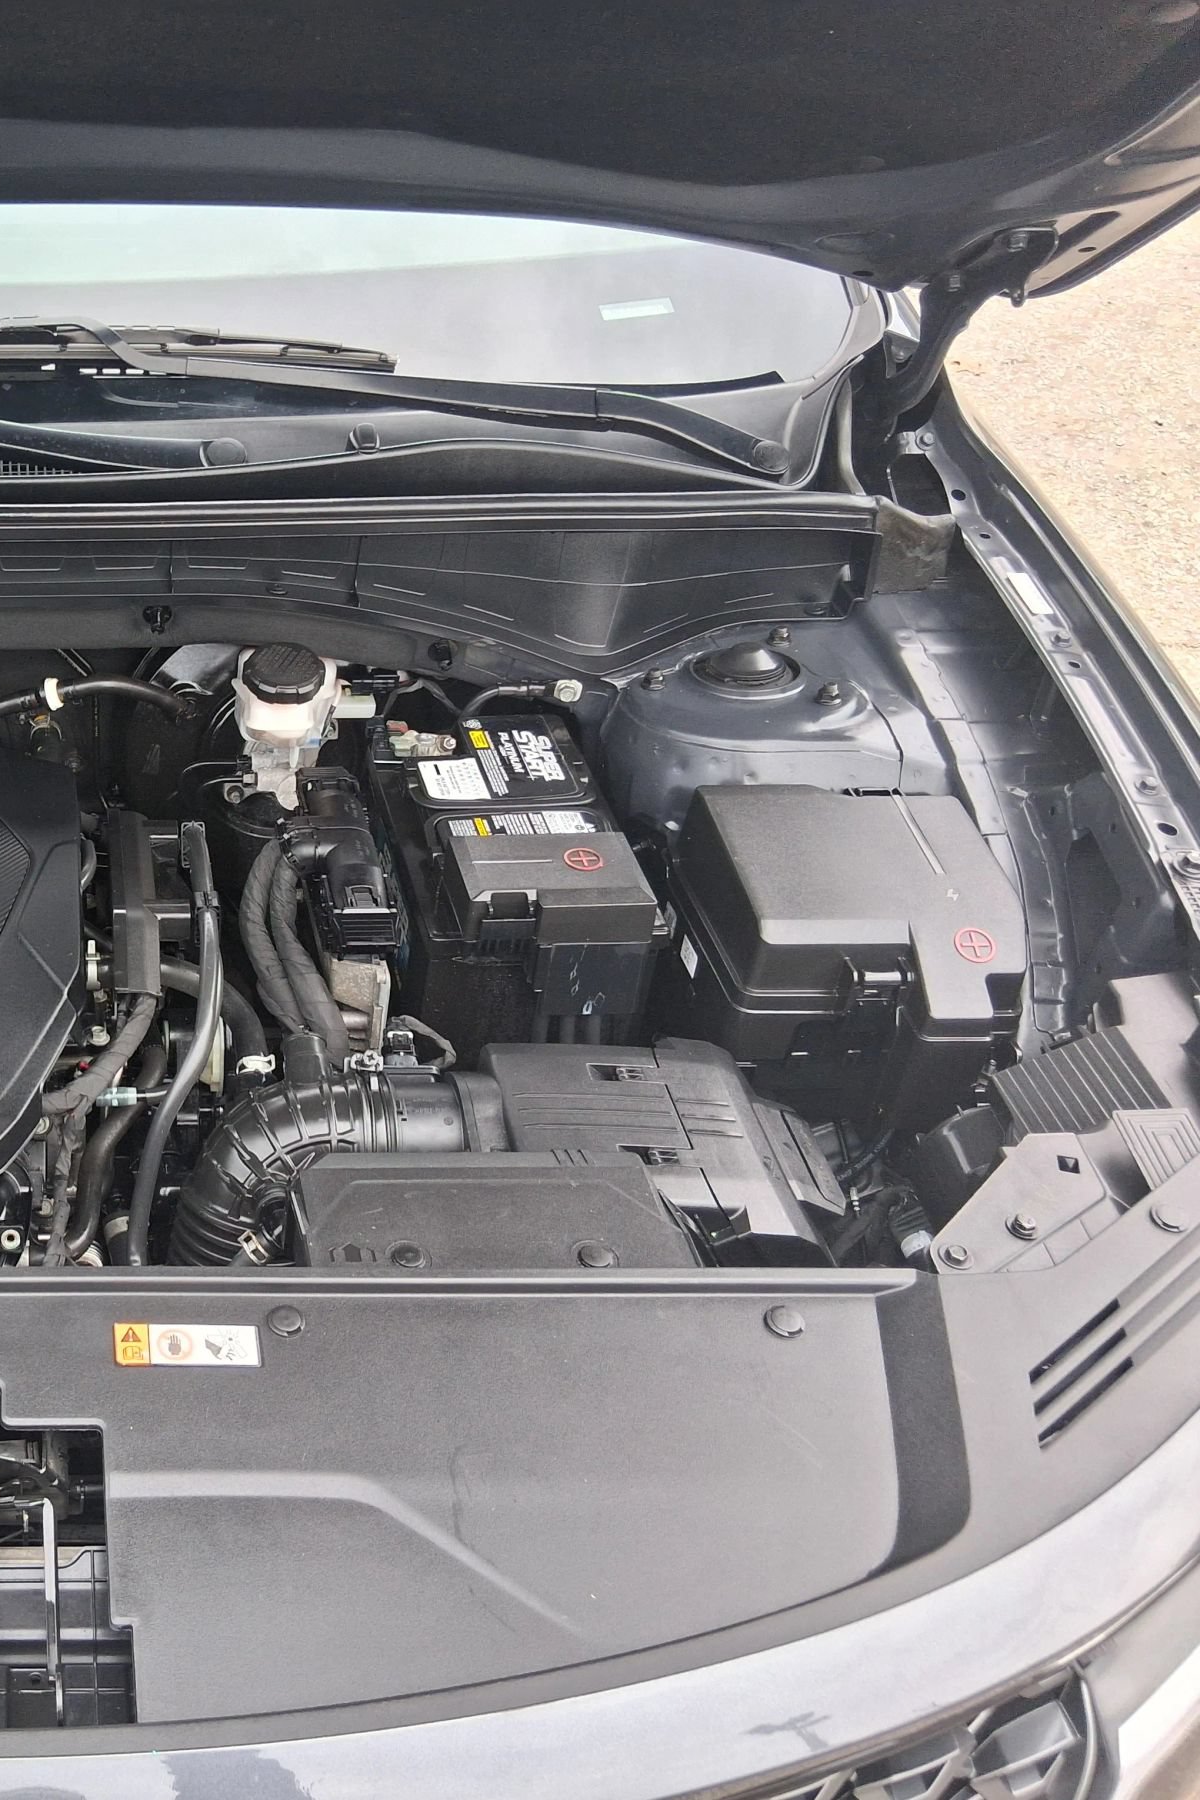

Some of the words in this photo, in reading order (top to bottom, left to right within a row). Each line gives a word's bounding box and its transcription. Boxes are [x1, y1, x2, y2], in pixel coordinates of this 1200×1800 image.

[498, 732, 525, 773] PLATINUM
[512, 730, 553, 782] START
[537, 735, 566, 781] SUPER
